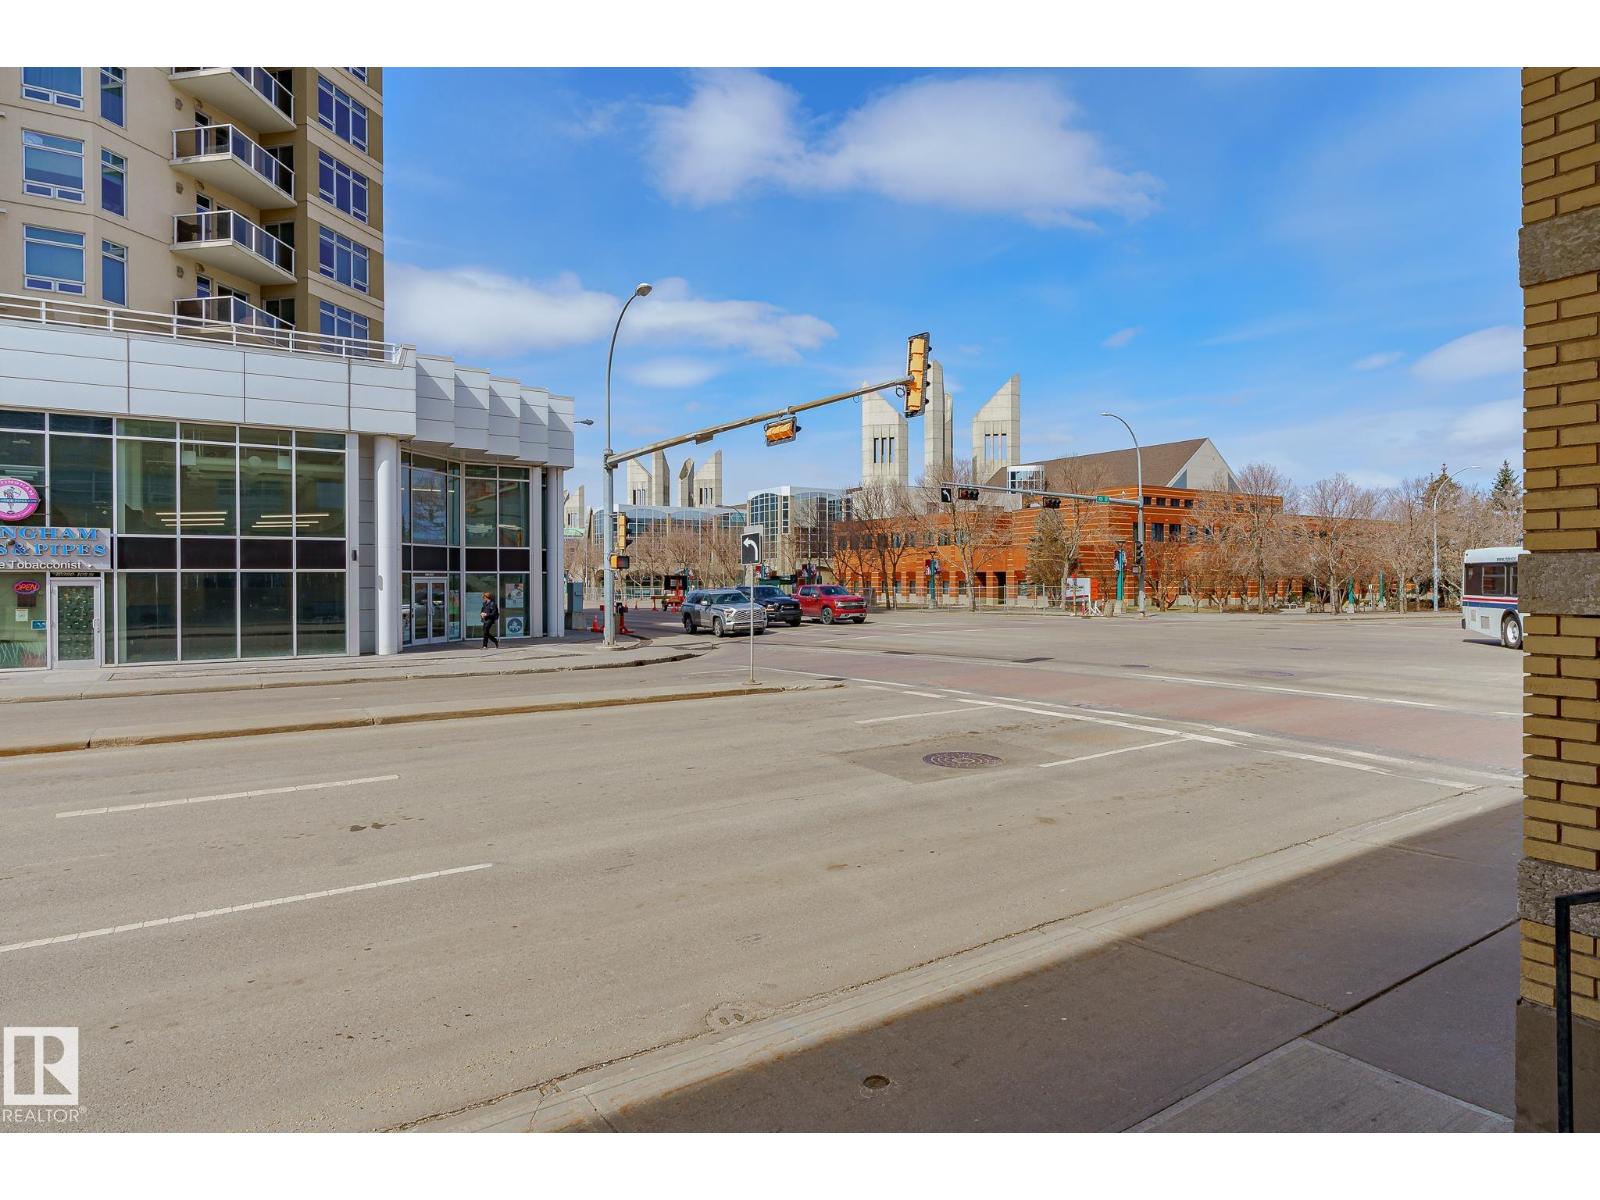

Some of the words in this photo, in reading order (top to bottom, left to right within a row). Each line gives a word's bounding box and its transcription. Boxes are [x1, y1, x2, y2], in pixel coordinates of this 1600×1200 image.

[33, 544, 107, 556] PIPES
[10, 561, 82, 570] Tobacconist
[17, 583, 37, 591] OPEN
